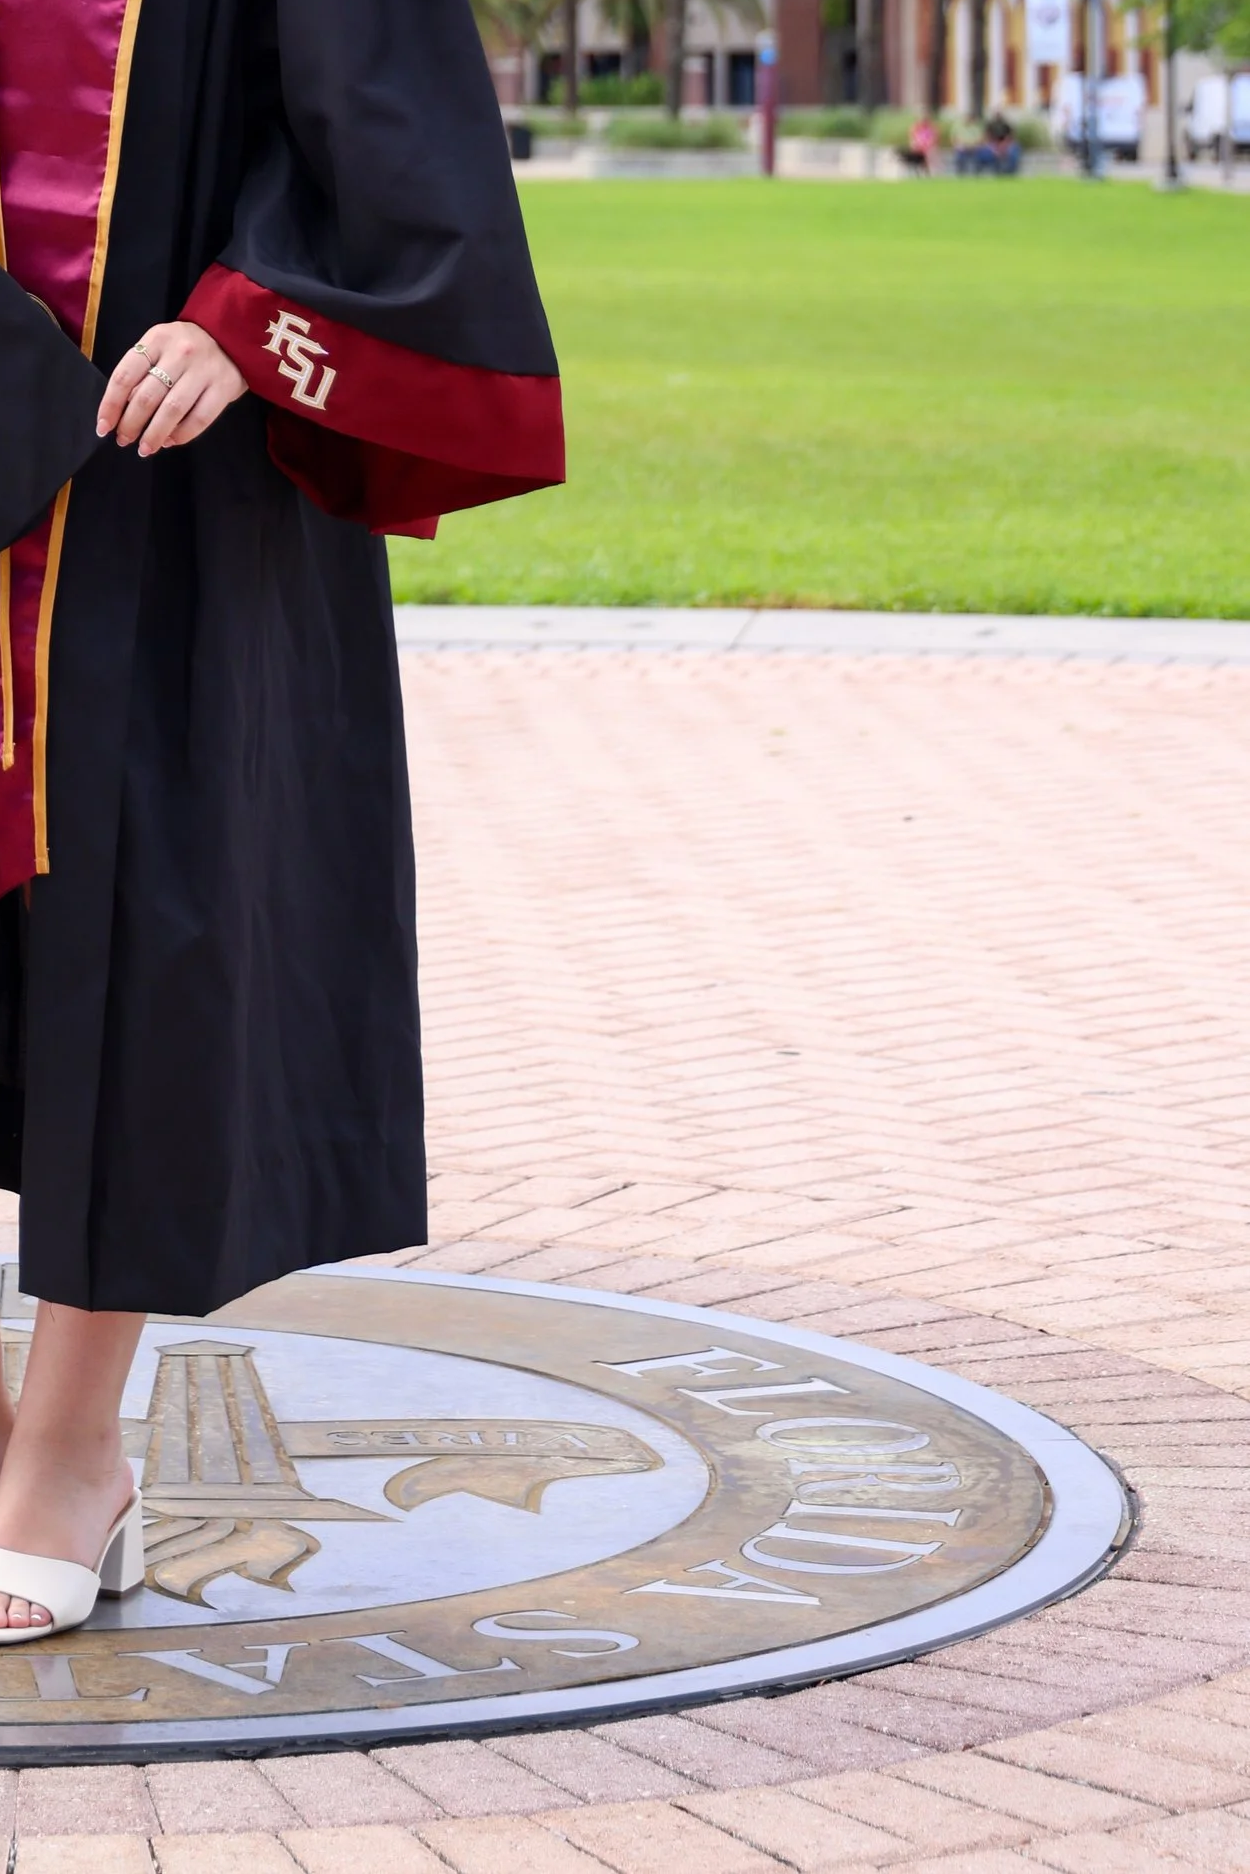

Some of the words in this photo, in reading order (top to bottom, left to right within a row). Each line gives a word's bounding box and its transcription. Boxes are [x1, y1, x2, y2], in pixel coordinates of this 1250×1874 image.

[262, 309, 337, 411] FSU
[327, 1429, 589, 1449] VIRES
[590, 1346, 962, 1606] FLORIDA
